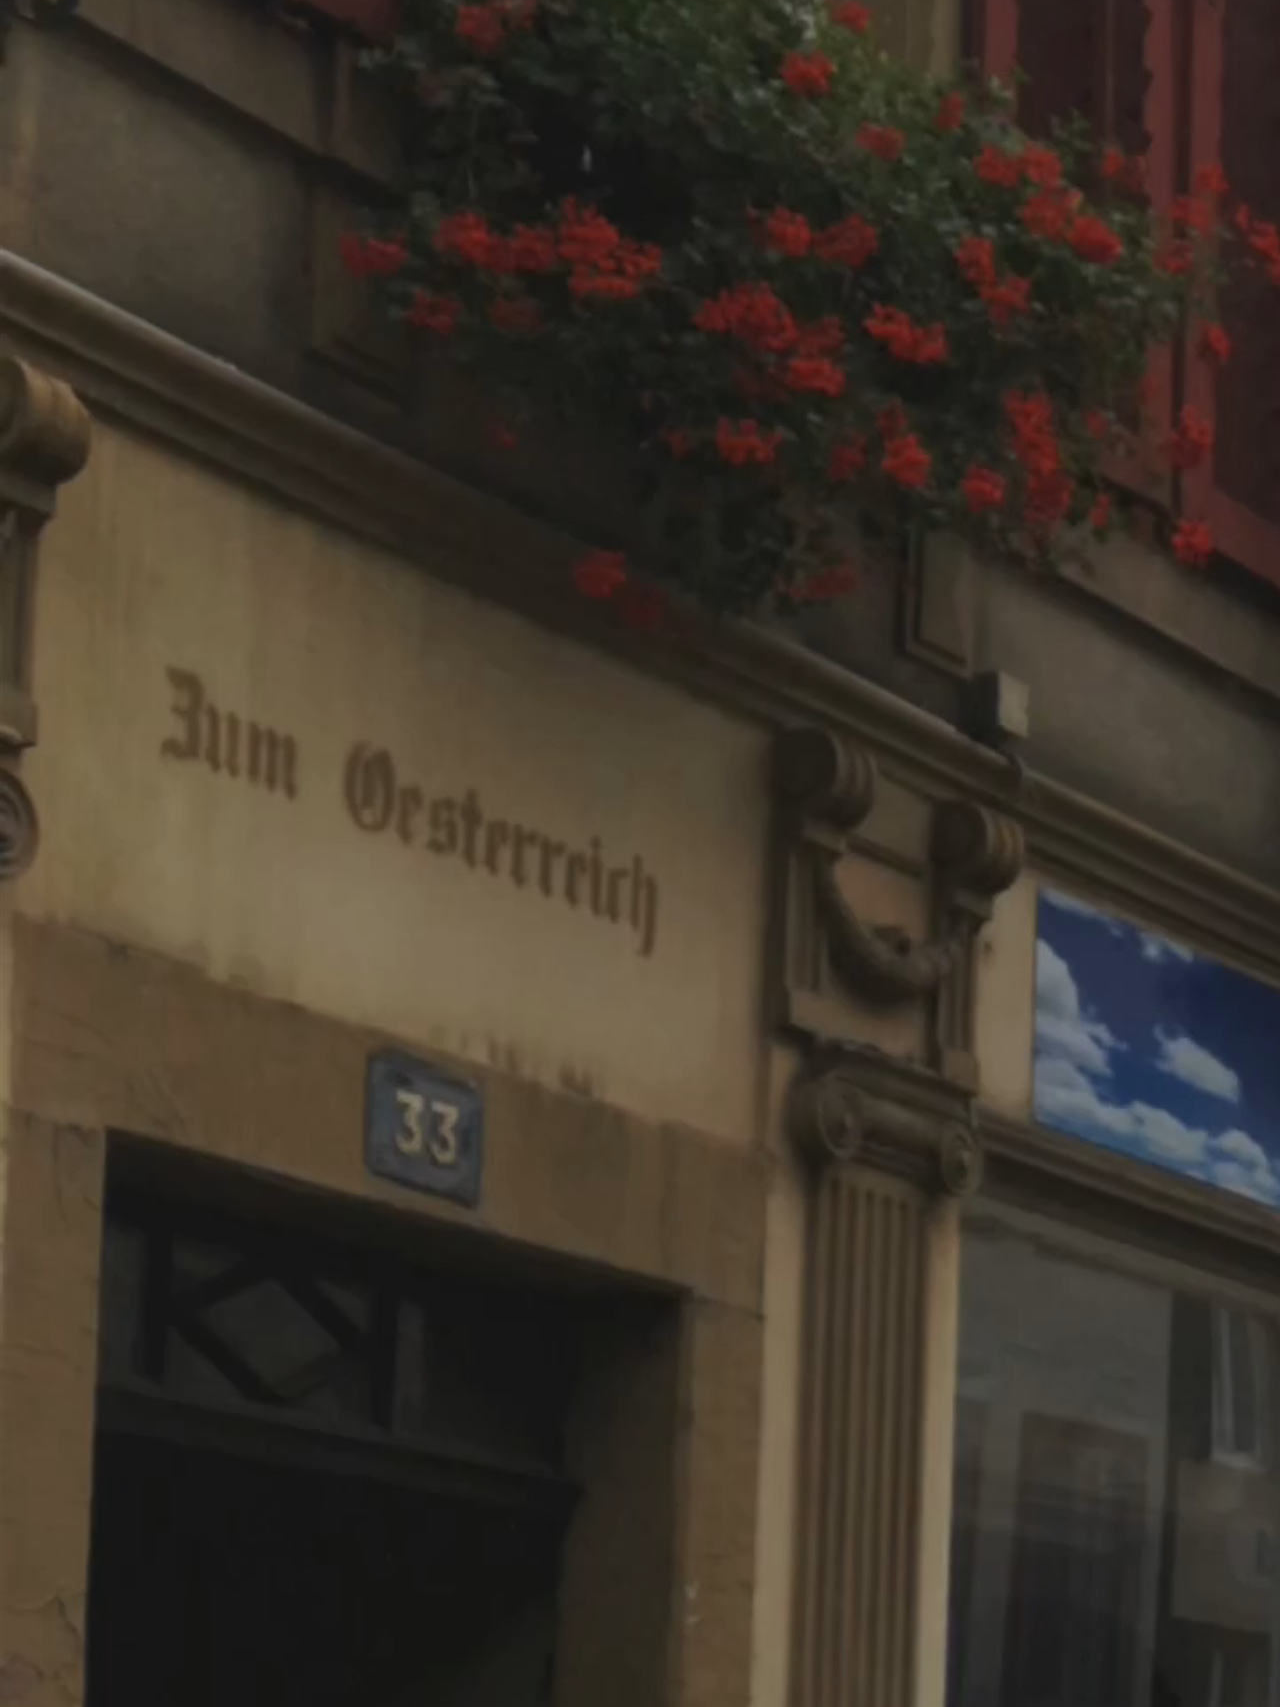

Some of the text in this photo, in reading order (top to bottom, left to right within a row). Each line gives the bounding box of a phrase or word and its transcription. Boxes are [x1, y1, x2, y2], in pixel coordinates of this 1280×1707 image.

[160, 665, 660, 959] Zum Oesterreich
[395, 1089, 459, 1164] 33
